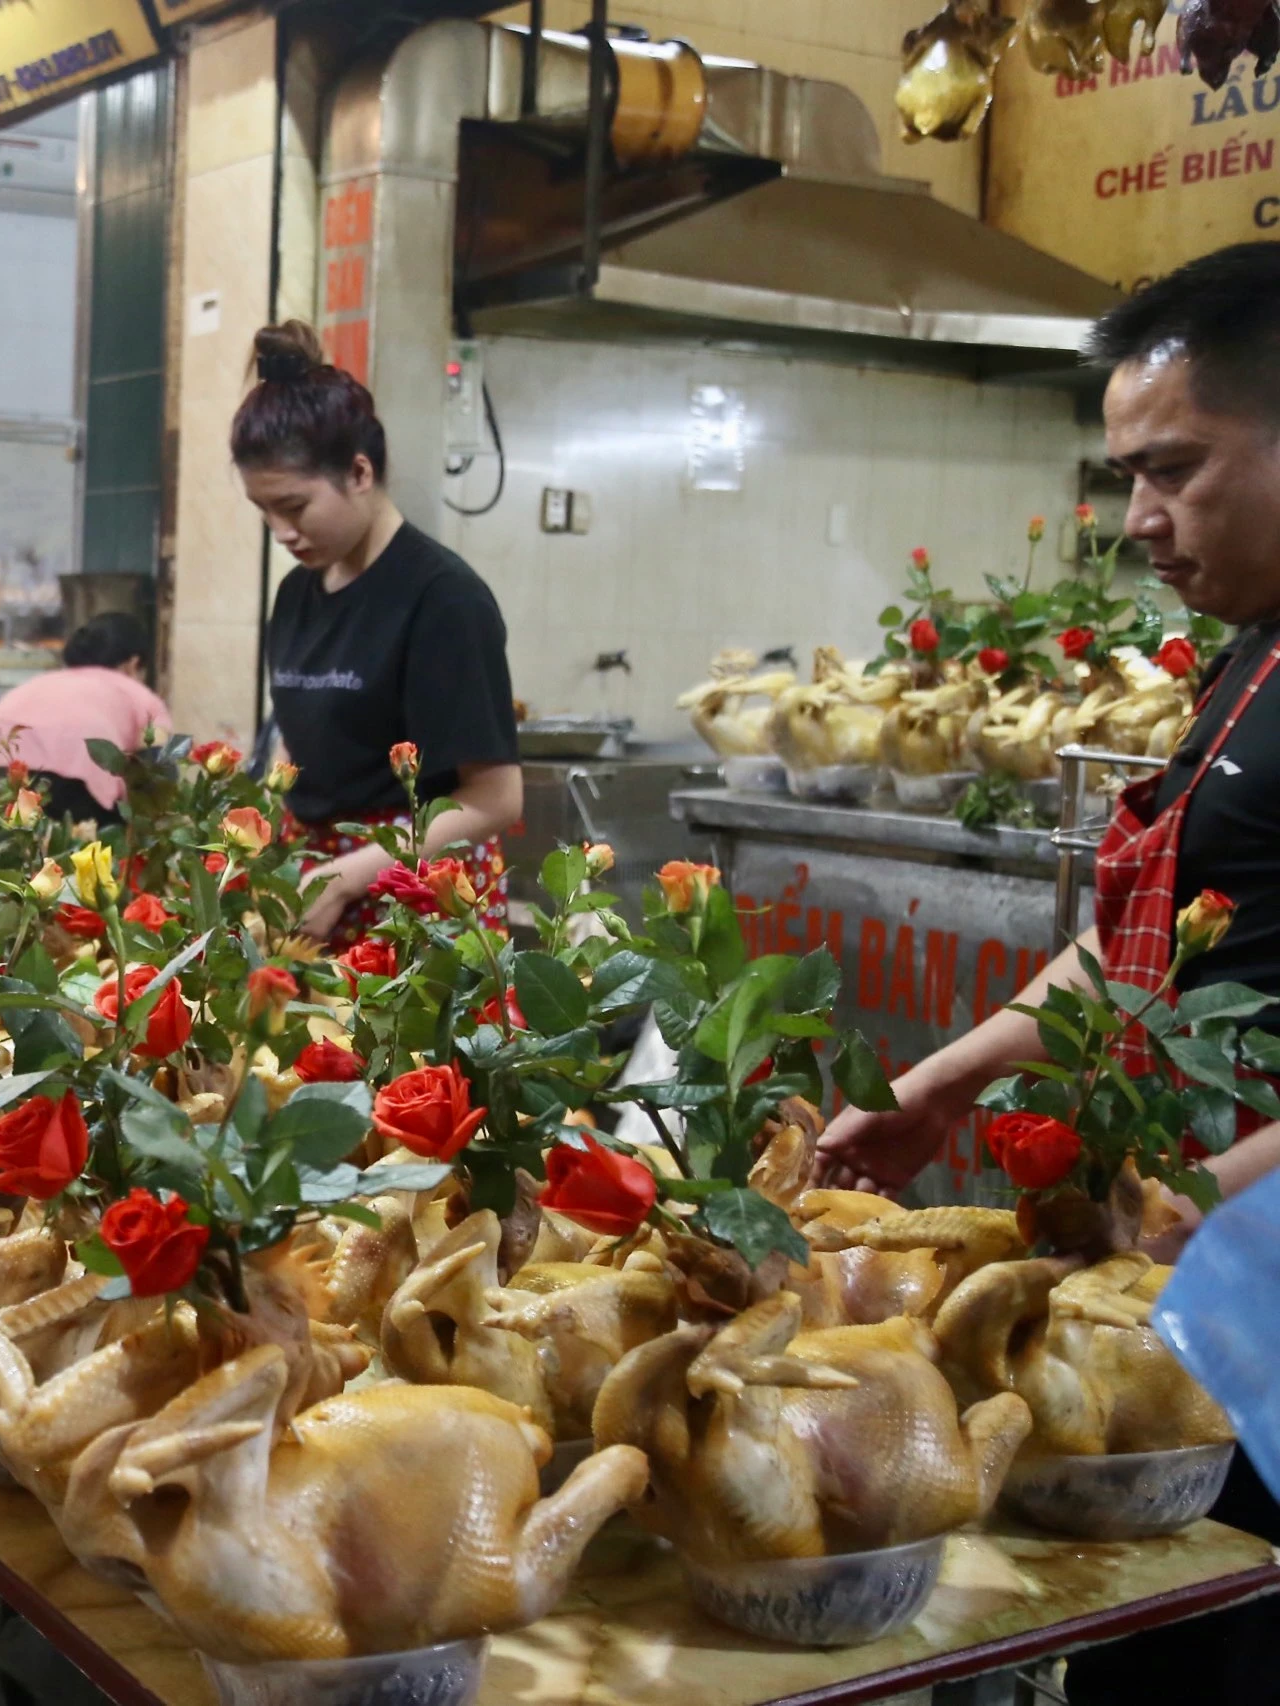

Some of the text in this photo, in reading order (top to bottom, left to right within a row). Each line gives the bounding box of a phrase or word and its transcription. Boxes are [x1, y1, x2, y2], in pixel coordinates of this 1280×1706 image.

[1095, 130, 1276, 200] CHẾ BIẾN
[858, 898, 958, 1030] BÁN
